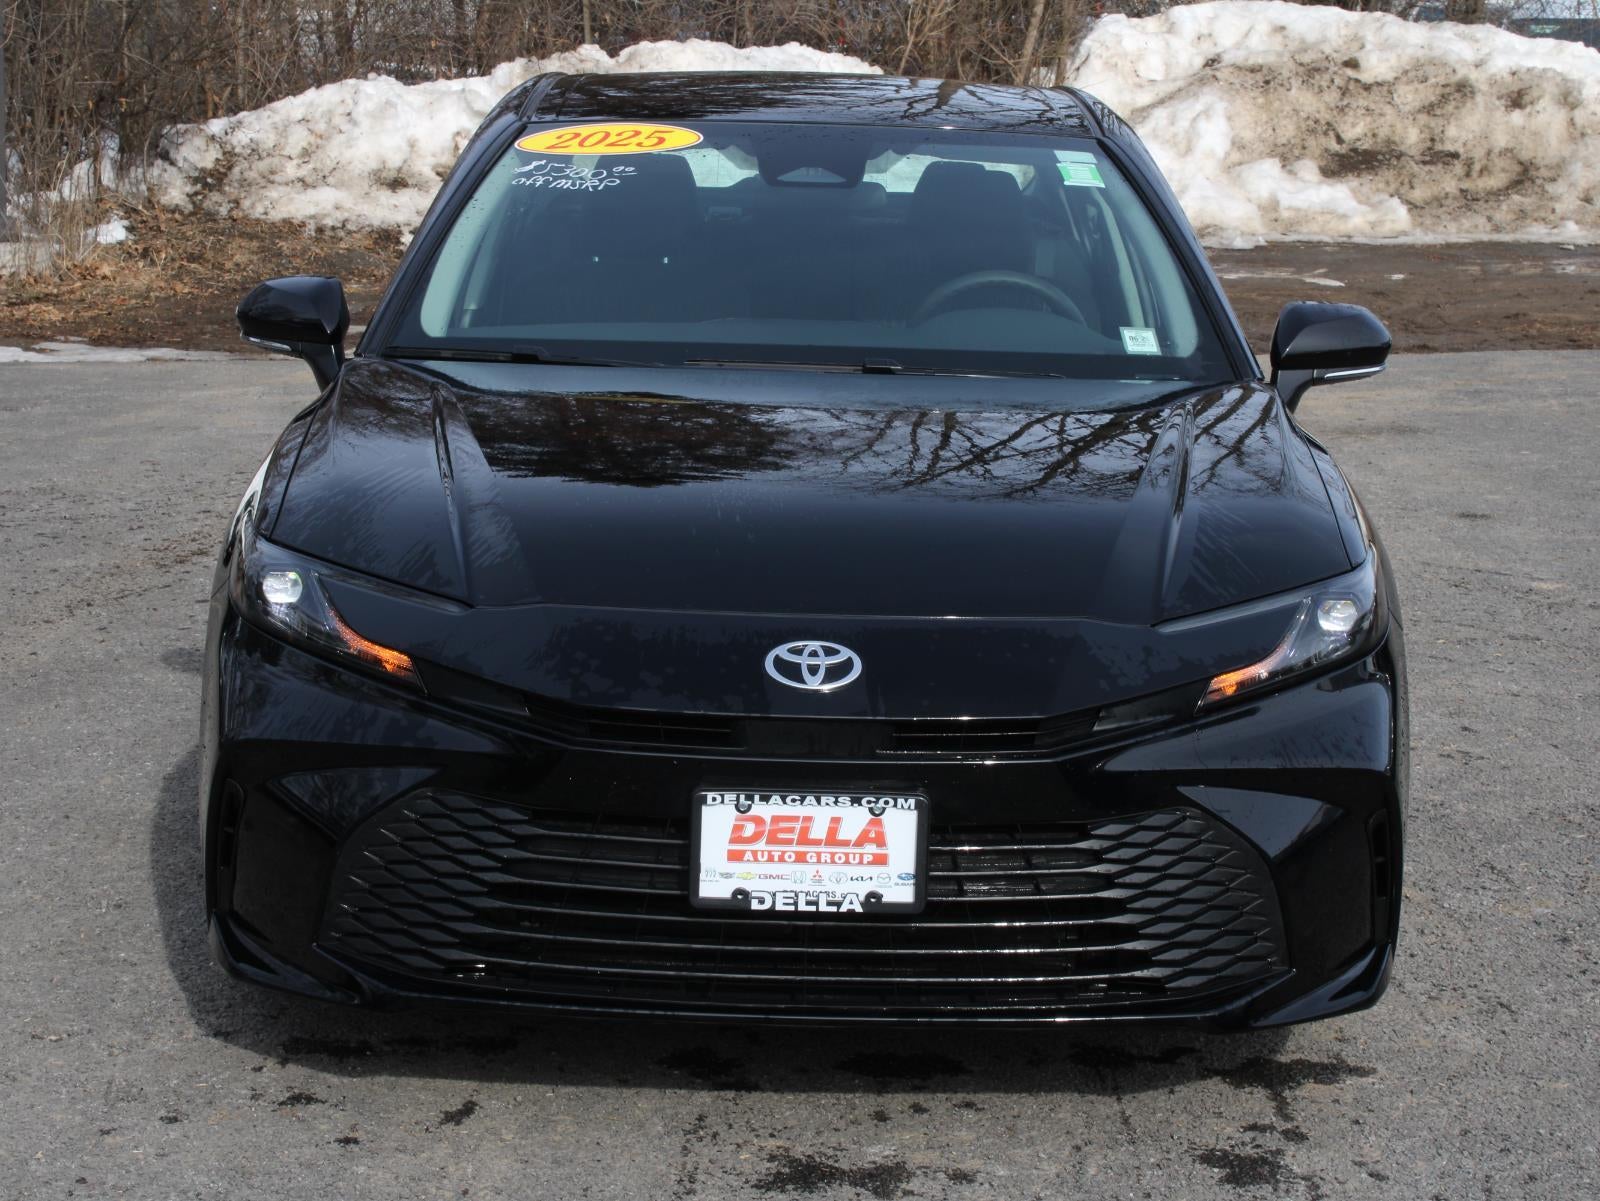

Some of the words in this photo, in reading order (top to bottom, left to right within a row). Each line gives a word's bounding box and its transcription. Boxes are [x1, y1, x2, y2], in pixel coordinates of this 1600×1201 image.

[545, 131, 673, 150] 2025
[706, 794, 915, 810] DELLACARS.COM
[728, 815, 888, 849] DELLA
[743, 851, 796, 863] AUTO
[806, 853, 874, 864] GROUP
[751, 890, 863, 912] DELLA
